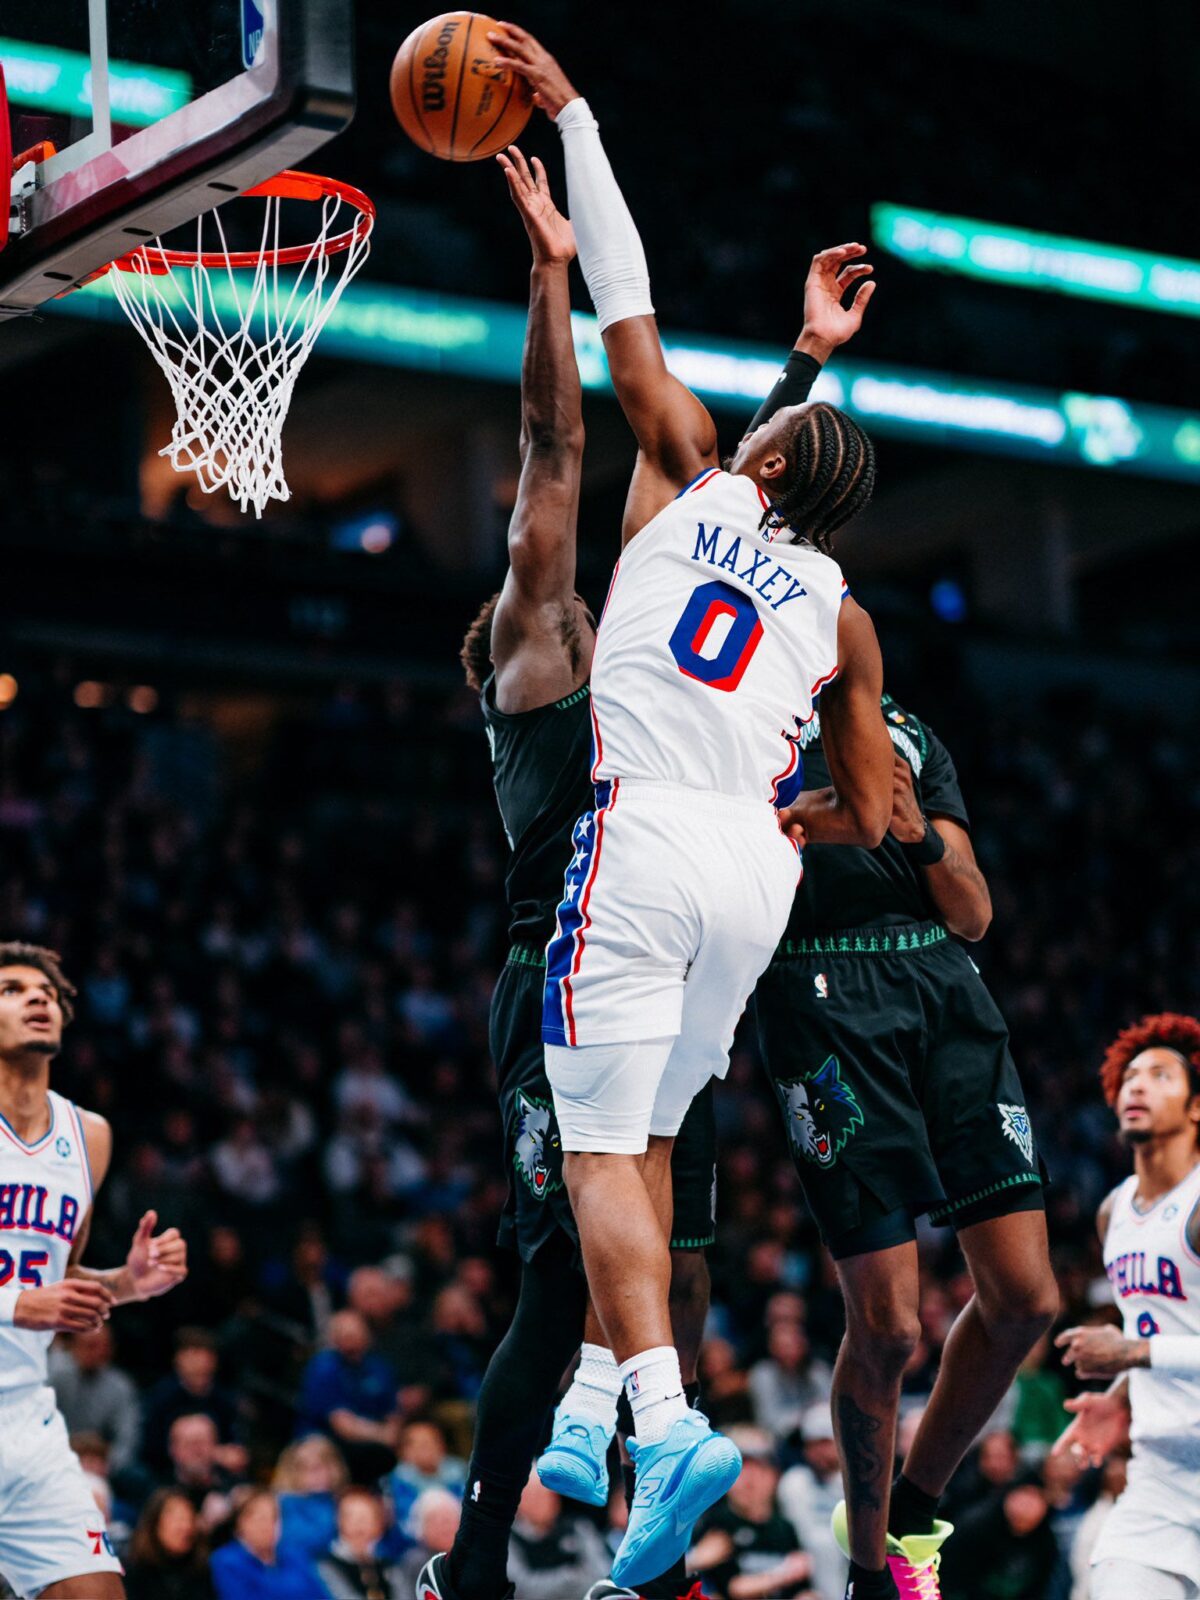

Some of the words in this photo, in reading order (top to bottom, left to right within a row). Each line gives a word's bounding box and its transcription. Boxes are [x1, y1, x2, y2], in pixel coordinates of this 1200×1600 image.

[248, 29, 263, 58] NB
[423, 22, 460, 111] Wilson
[691, 522, 807, 611] MAXEY
[668, 580, 765, 692] 0
